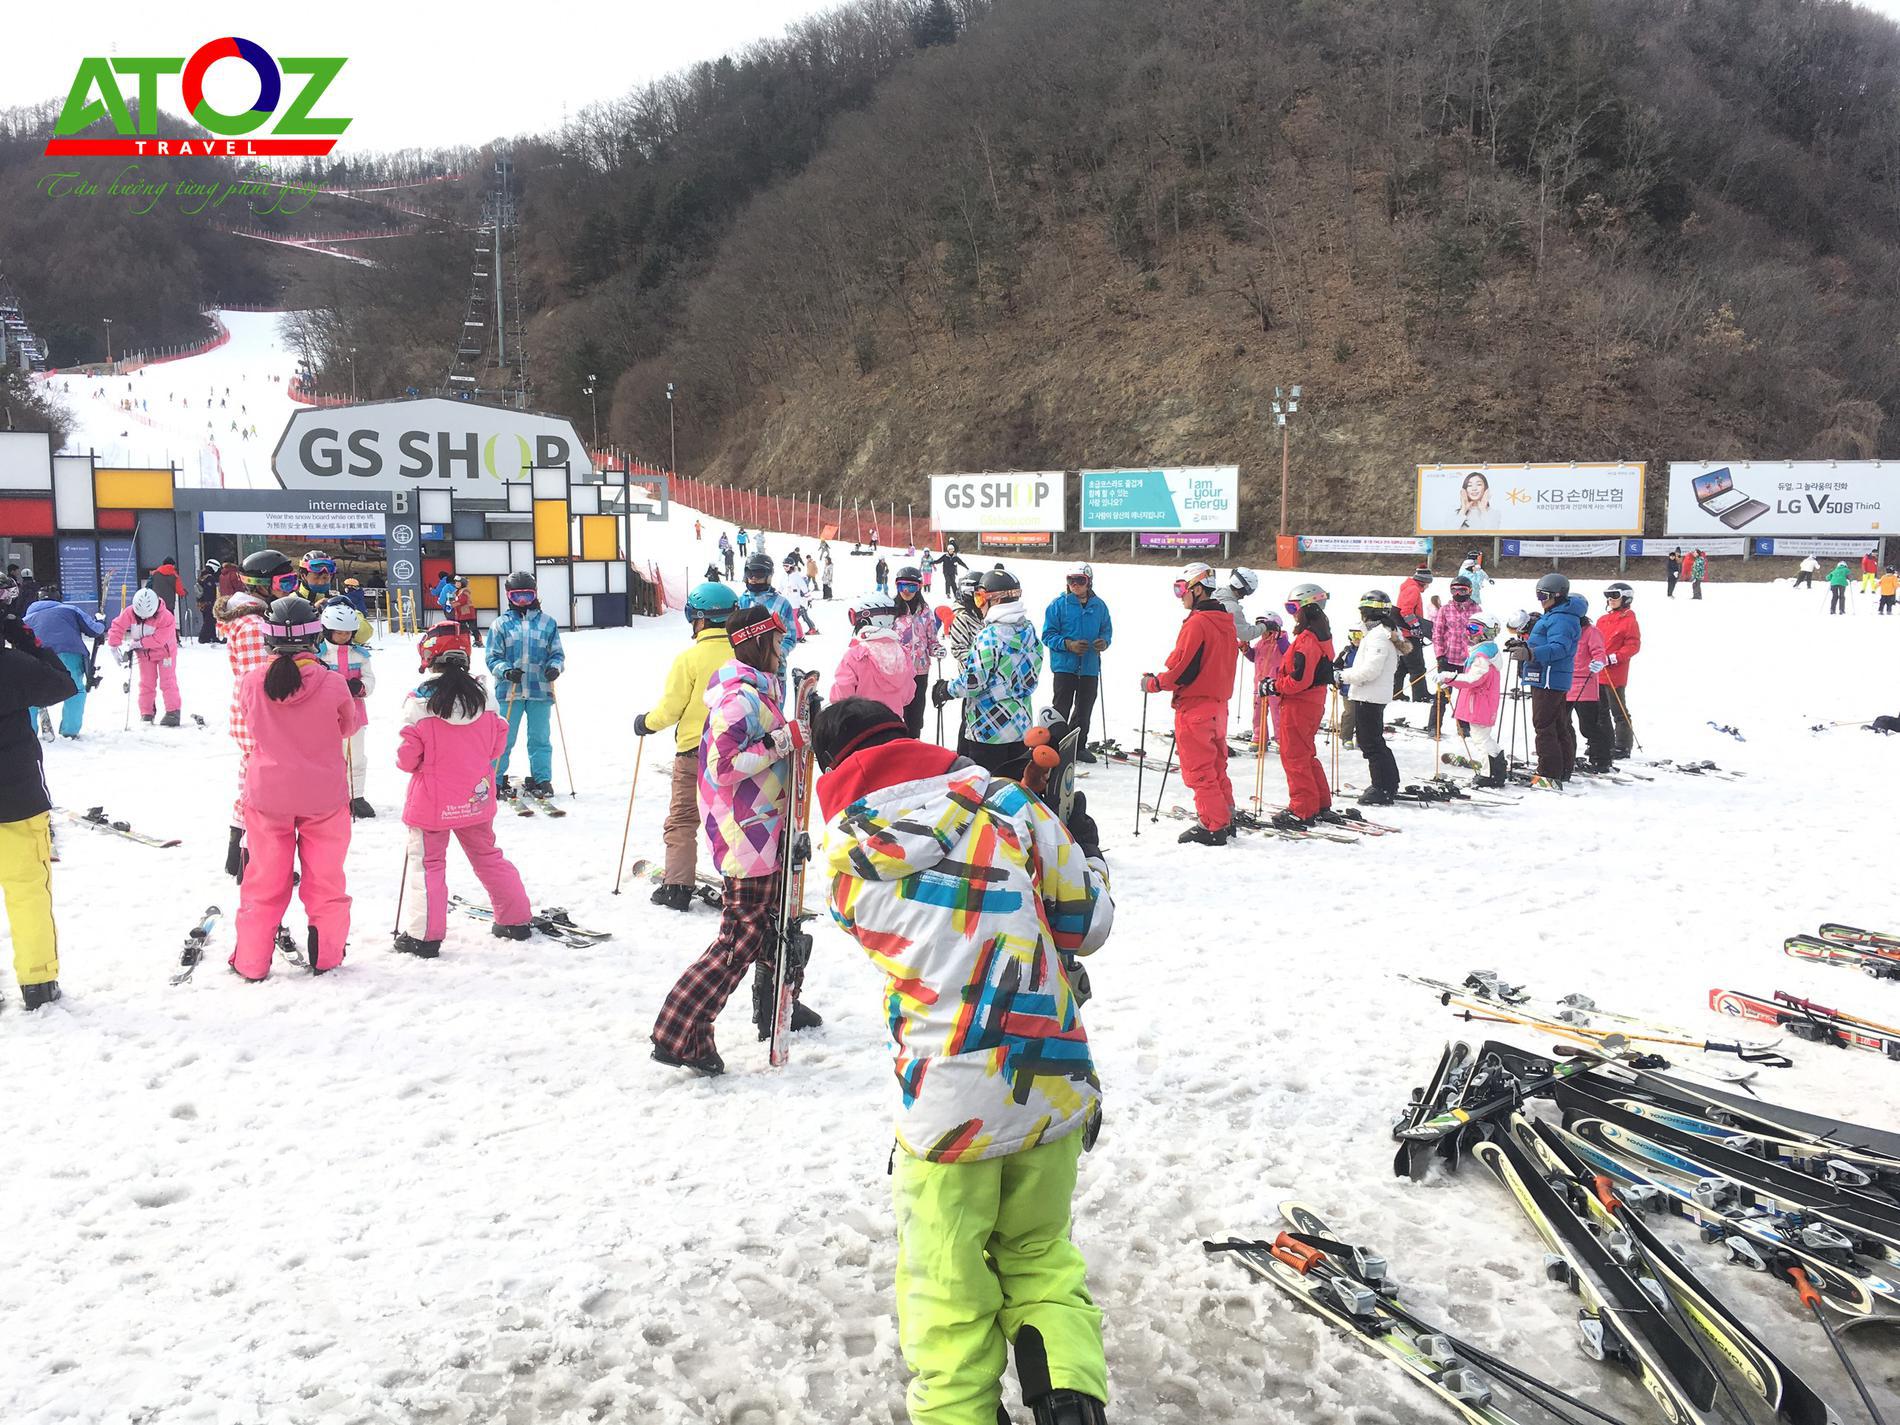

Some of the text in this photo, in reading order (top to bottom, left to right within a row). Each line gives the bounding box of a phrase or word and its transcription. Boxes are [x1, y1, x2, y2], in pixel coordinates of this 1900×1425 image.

[299, 428, 570, 481] GS SHOP
[1188, 478, 1213, 489] I am
[945, 482, 1049, 509] GS SHOP
[1194, 488, 1223, 500] your
[1537, 488, 1624, 503] KB 손해보험
[308, 490, 408, 514] intermediate B
[1184, 498, 1228, 511] Energy
[1777, 500, 1802, 514] LG
[1854, 502, 1880, 510] ThinQ
[312, 513, 330, 521] board
